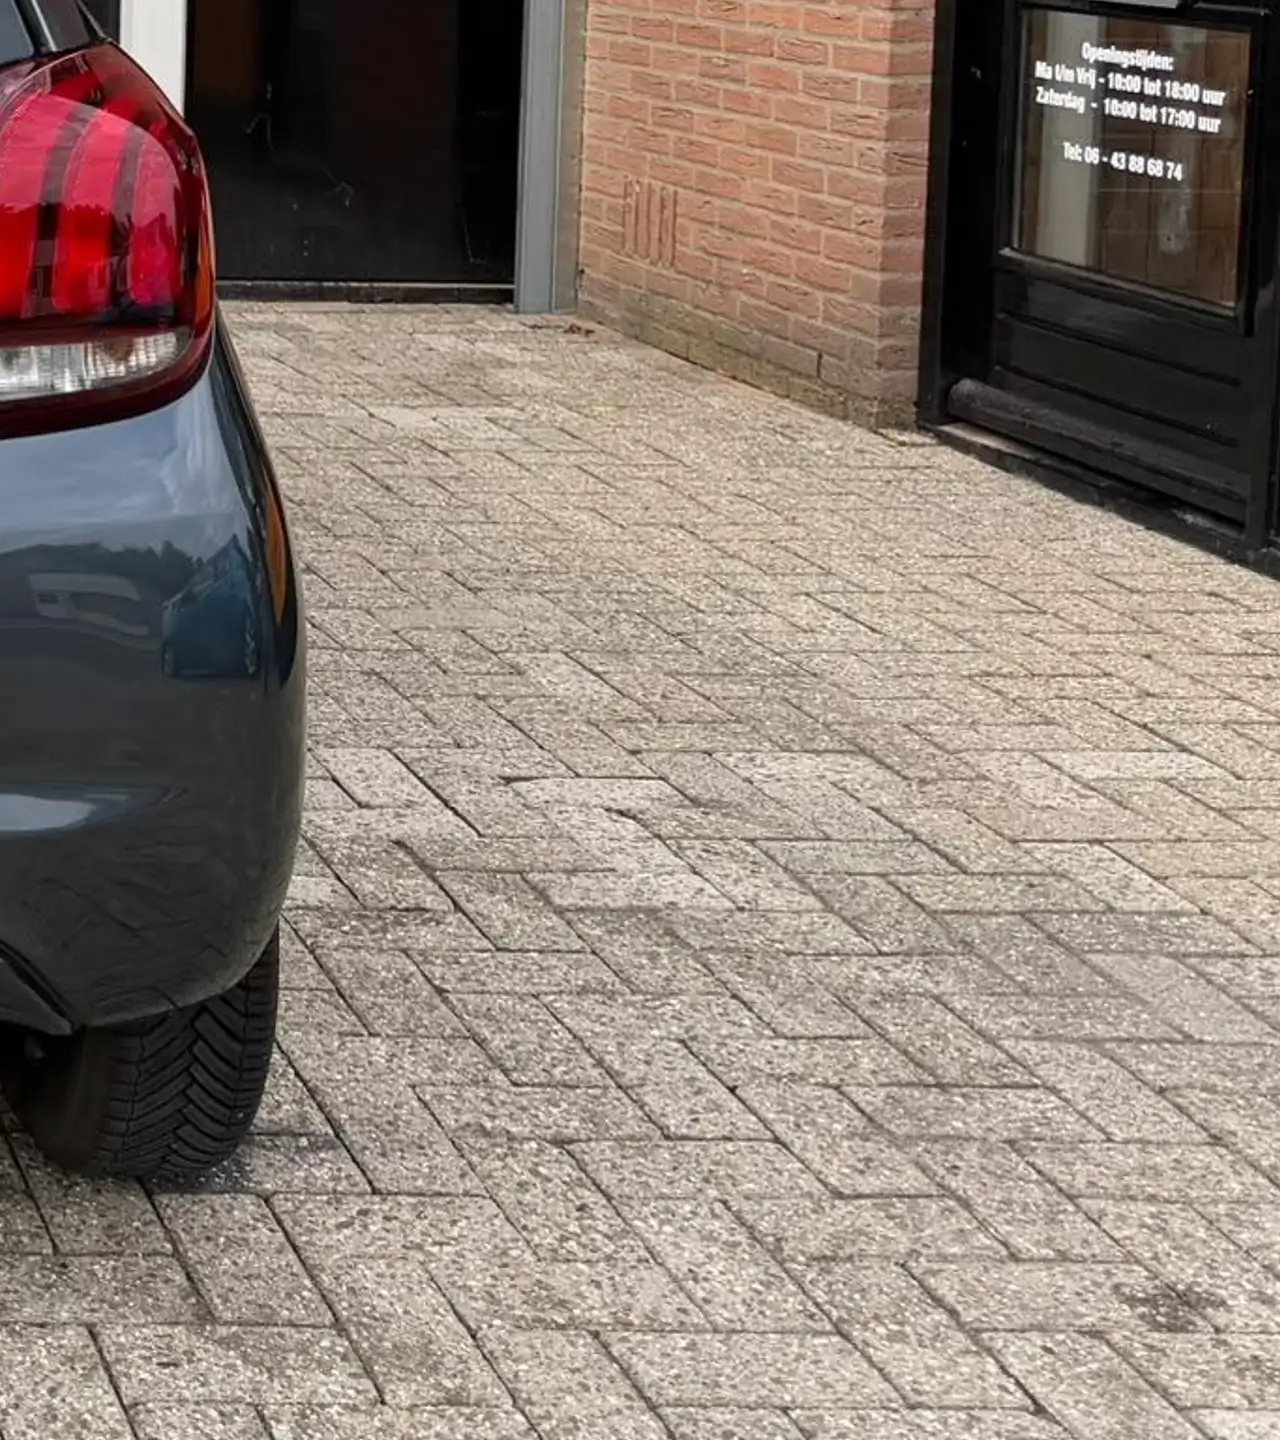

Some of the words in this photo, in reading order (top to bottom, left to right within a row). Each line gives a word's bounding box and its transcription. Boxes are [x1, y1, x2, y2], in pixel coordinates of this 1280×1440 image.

[1107, 72, 1141, 93] 10:00
[1143, 77, 1162, 97] tot
[1202, 89, 1226, 107] uur
[1103, 98, 1138, 119] 10:00
[1139, 104, 1158, 123] tot
[1198, 115, 1221, 133] uur
[1167, 162, 1183, 181] 74
